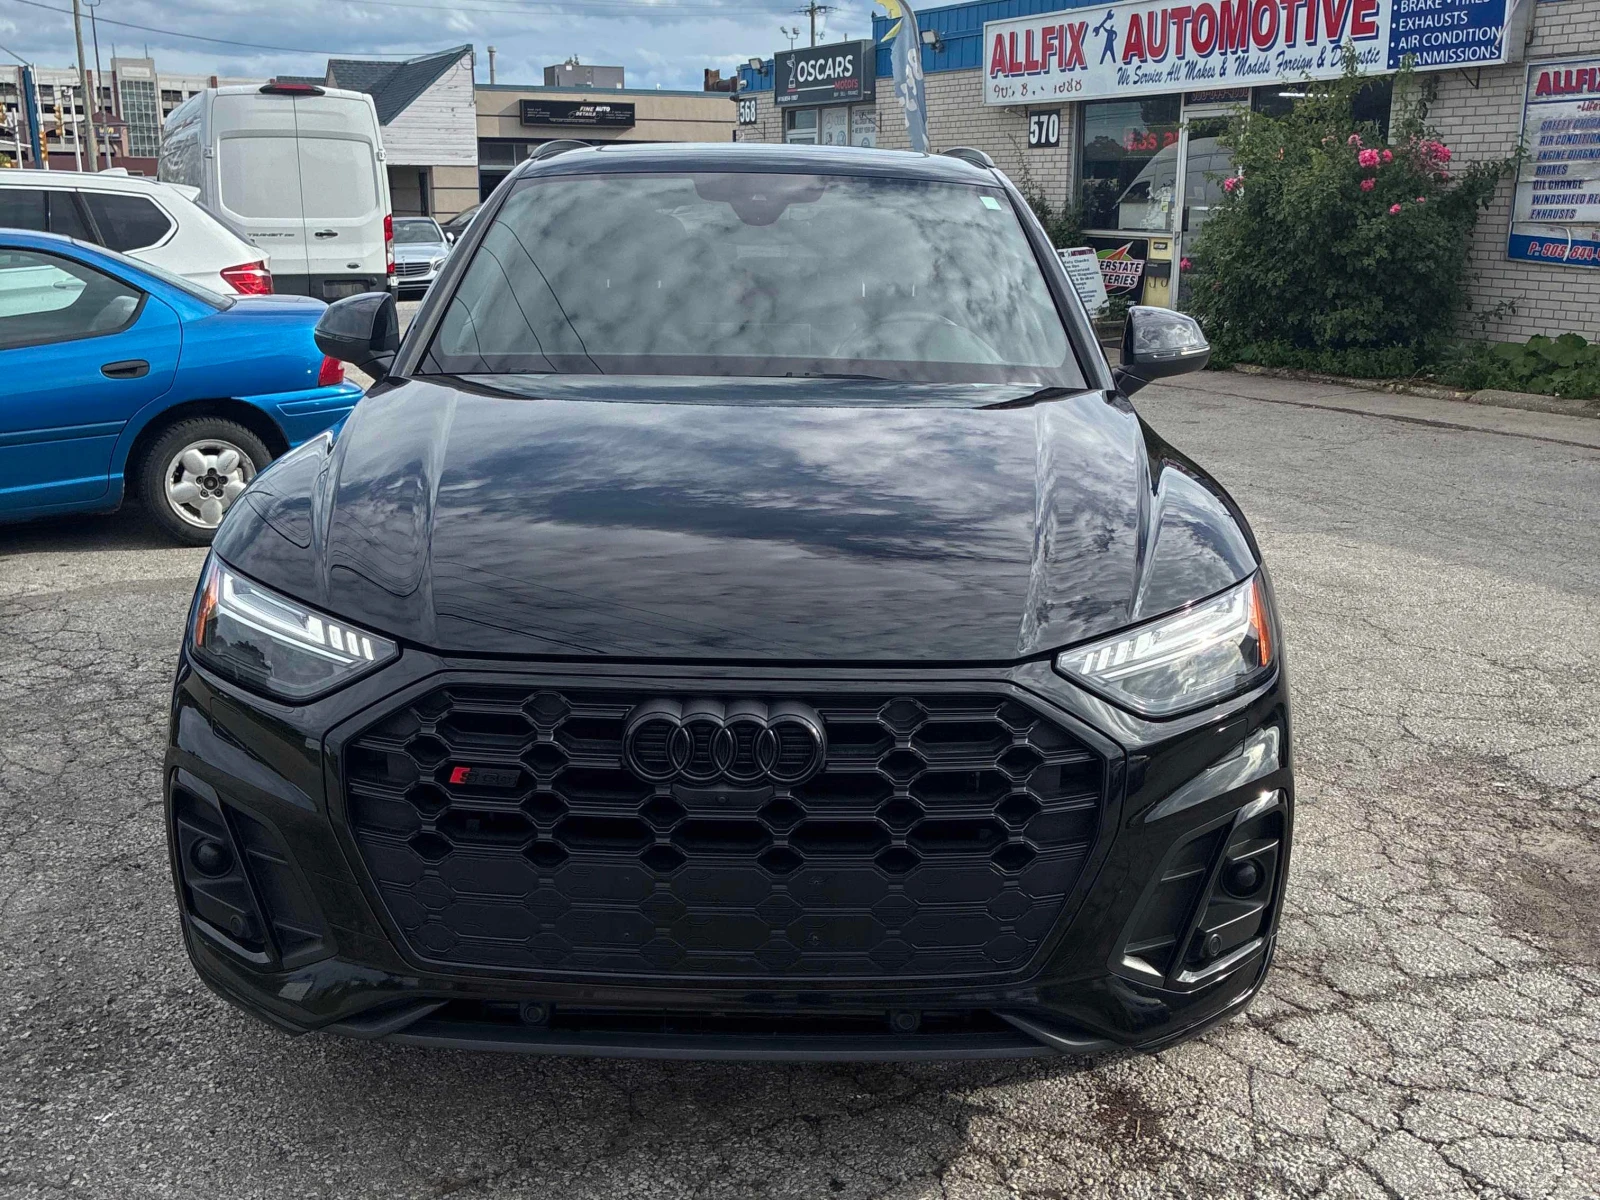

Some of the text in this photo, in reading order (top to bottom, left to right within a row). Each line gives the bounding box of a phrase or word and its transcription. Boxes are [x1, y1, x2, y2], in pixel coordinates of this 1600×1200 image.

[1399, 10, 1468, 31] EXHAUSTS
[989, 0, 1380, 79] ALLFIX AUTOMOTIVE
[1398, 26, 1502, 50] AIR CONDITION
[797, 54, 853, 83] OSCARS
[1117, 66, 1130, 86] We
[1133, 65, 1163, 85] Service
[1165, 61, 1181, 83] All
[1184, 59, 1216, 81] Makes
[1234, 54, 1271, 76] Models
[1275, 50, 1314, 77] Foreign
[1330, 44, 1381, 67] Doestic
[739, 100, 756, 123] 568
[1029, 113, 1059, 145] 570
[1537, 149, 1567, 161] ENGINE
[1535, 164, 1568, 176] BRAKES
[1532, 179, 1584, 190] OIL CHANGE
[1531, 193, 1586, 206] WINDSHIELD
[1530, 208, 1577, 220] EXHAUSTS
[1101, 273, 1136, 286] TERIES
